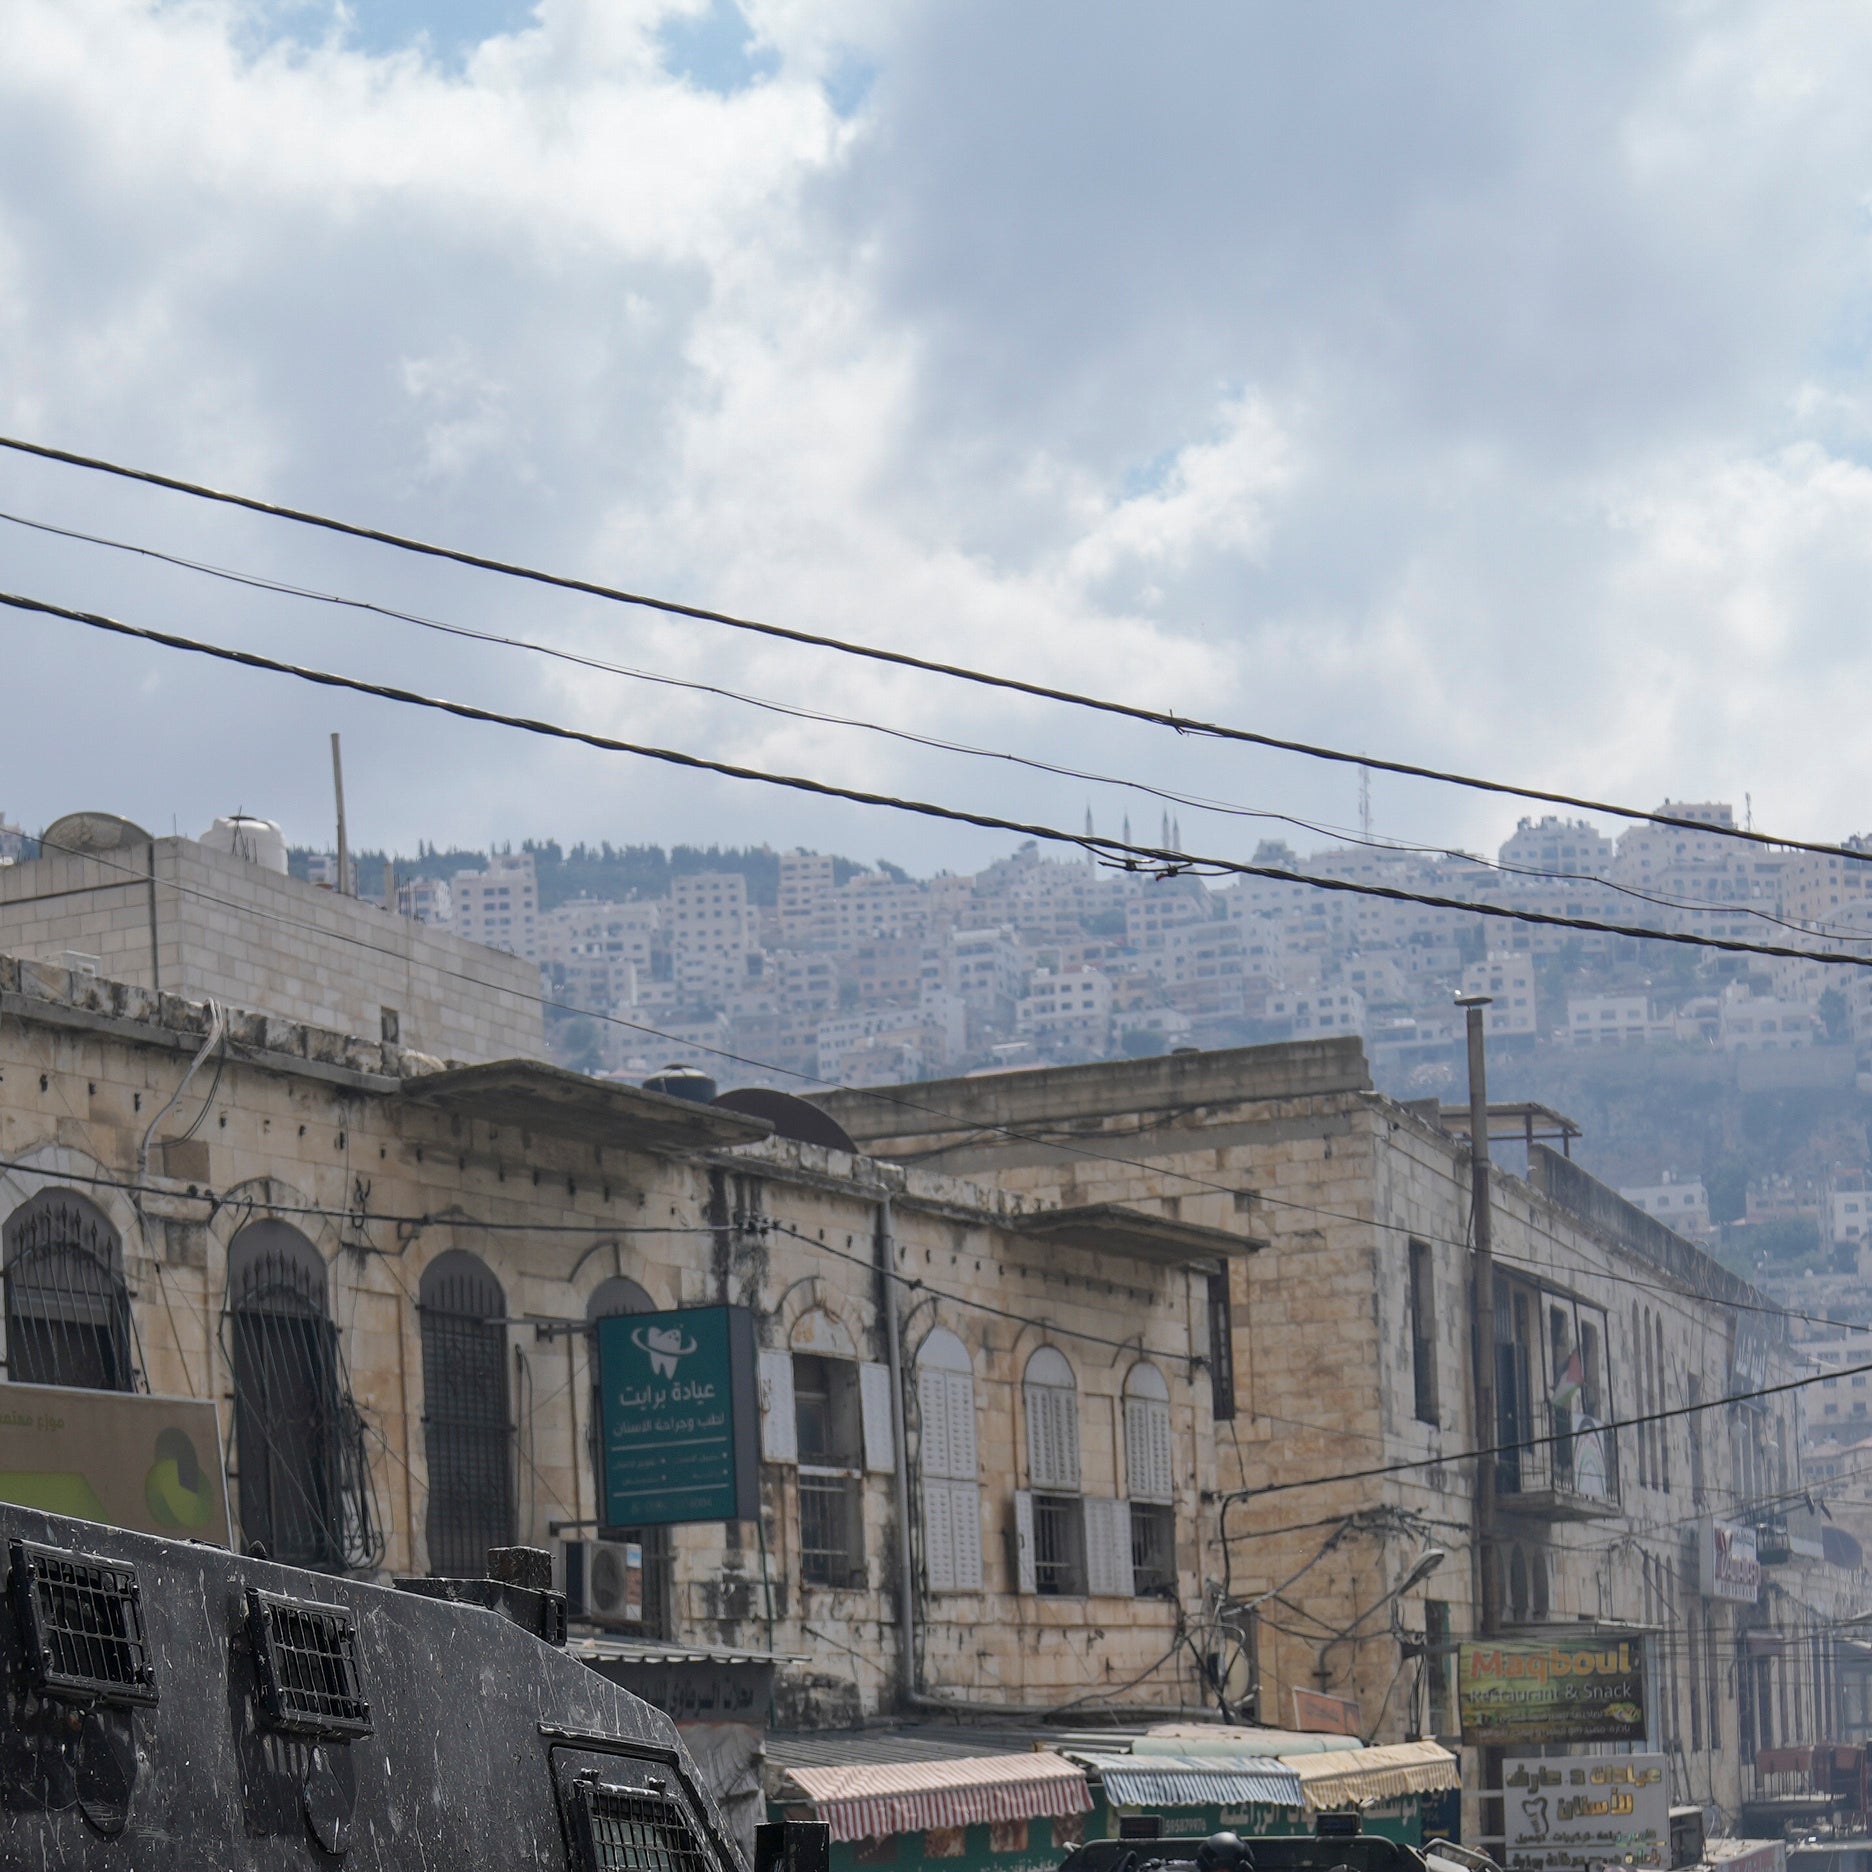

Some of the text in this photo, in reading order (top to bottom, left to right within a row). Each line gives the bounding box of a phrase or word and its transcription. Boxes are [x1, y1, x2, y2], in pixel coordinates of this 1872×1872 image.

[619, 1381, 716, 1411] عيادة برايت
[1470, 1643, 1632, 1685] Maqboul
[1564, 1683, 1577, 1700] &
[1583, 1681, 1632, 1699] Snack
[1590, 1763, 1662, 1788] عيادات
